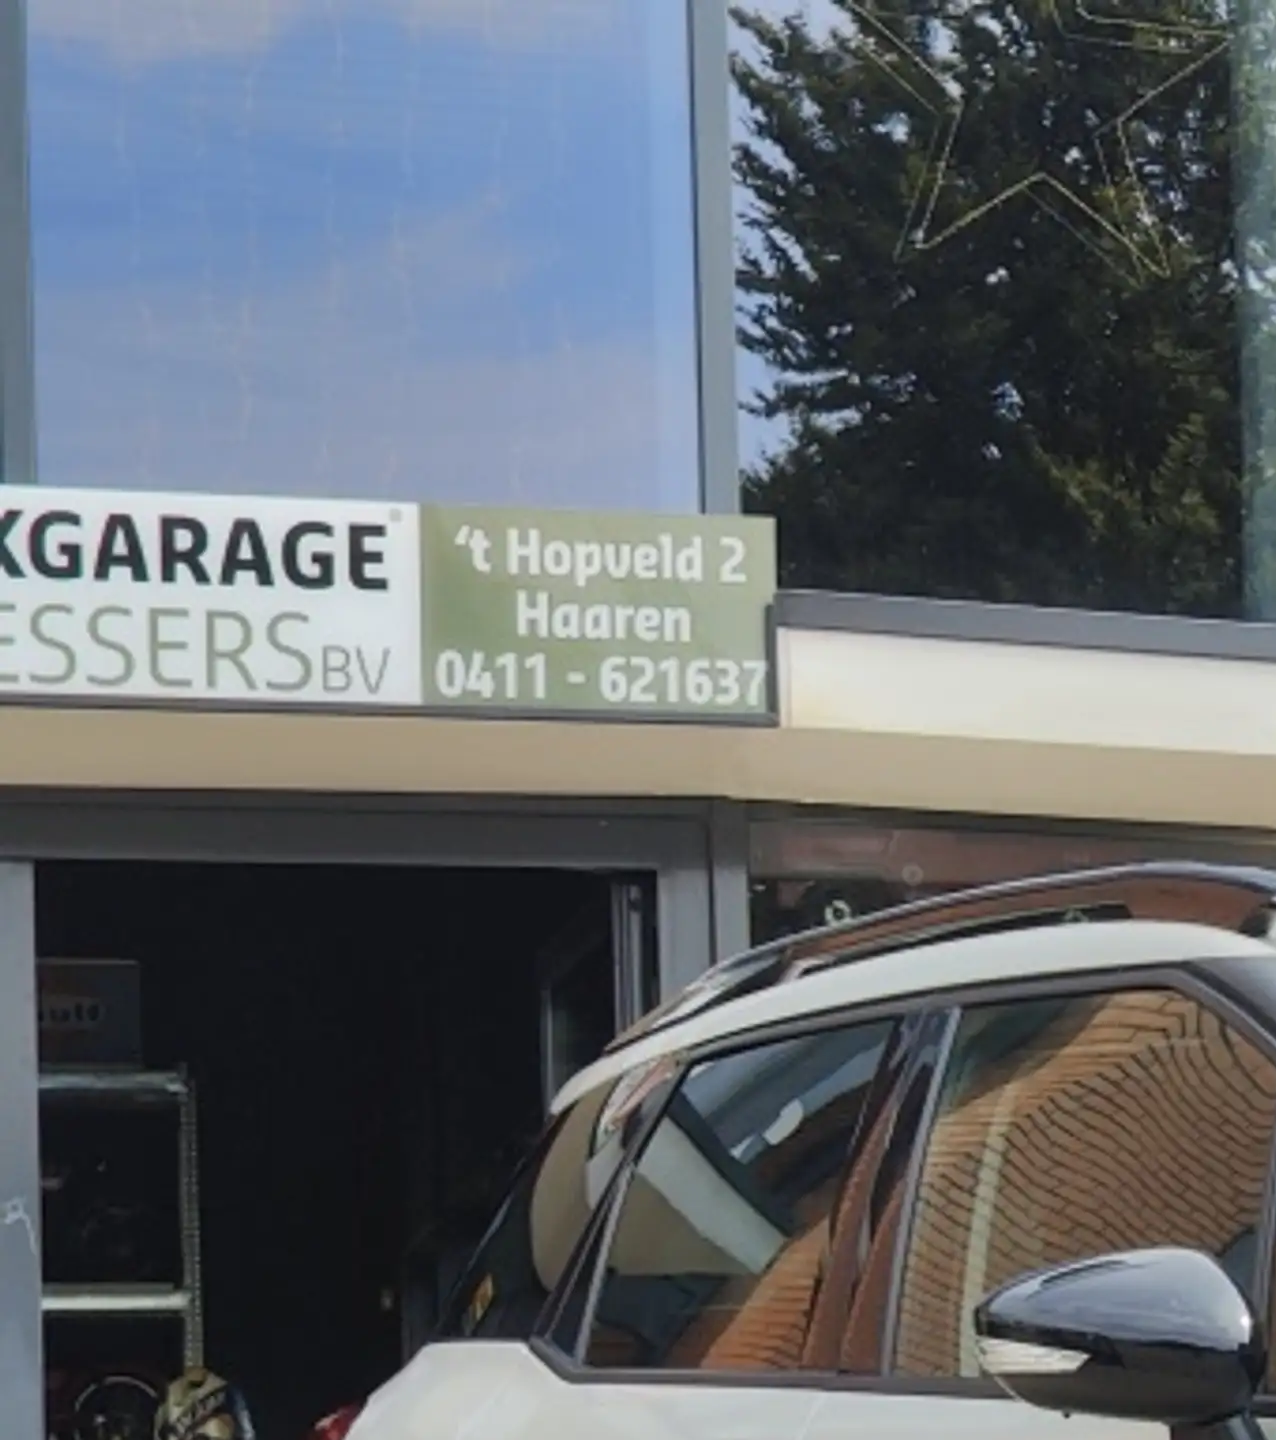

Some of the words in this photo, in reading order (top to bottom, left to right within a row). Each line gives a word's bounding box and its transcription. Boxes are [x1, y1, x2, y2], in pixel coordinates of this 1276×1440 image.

[506, 527, 703, 587] Hopveld
[719, 536, 748, 583] 2
[516, 590, 692, 643] Haaren
[435, 650, 546, 699] 0411
[599, 655, 769, 706] 621637
